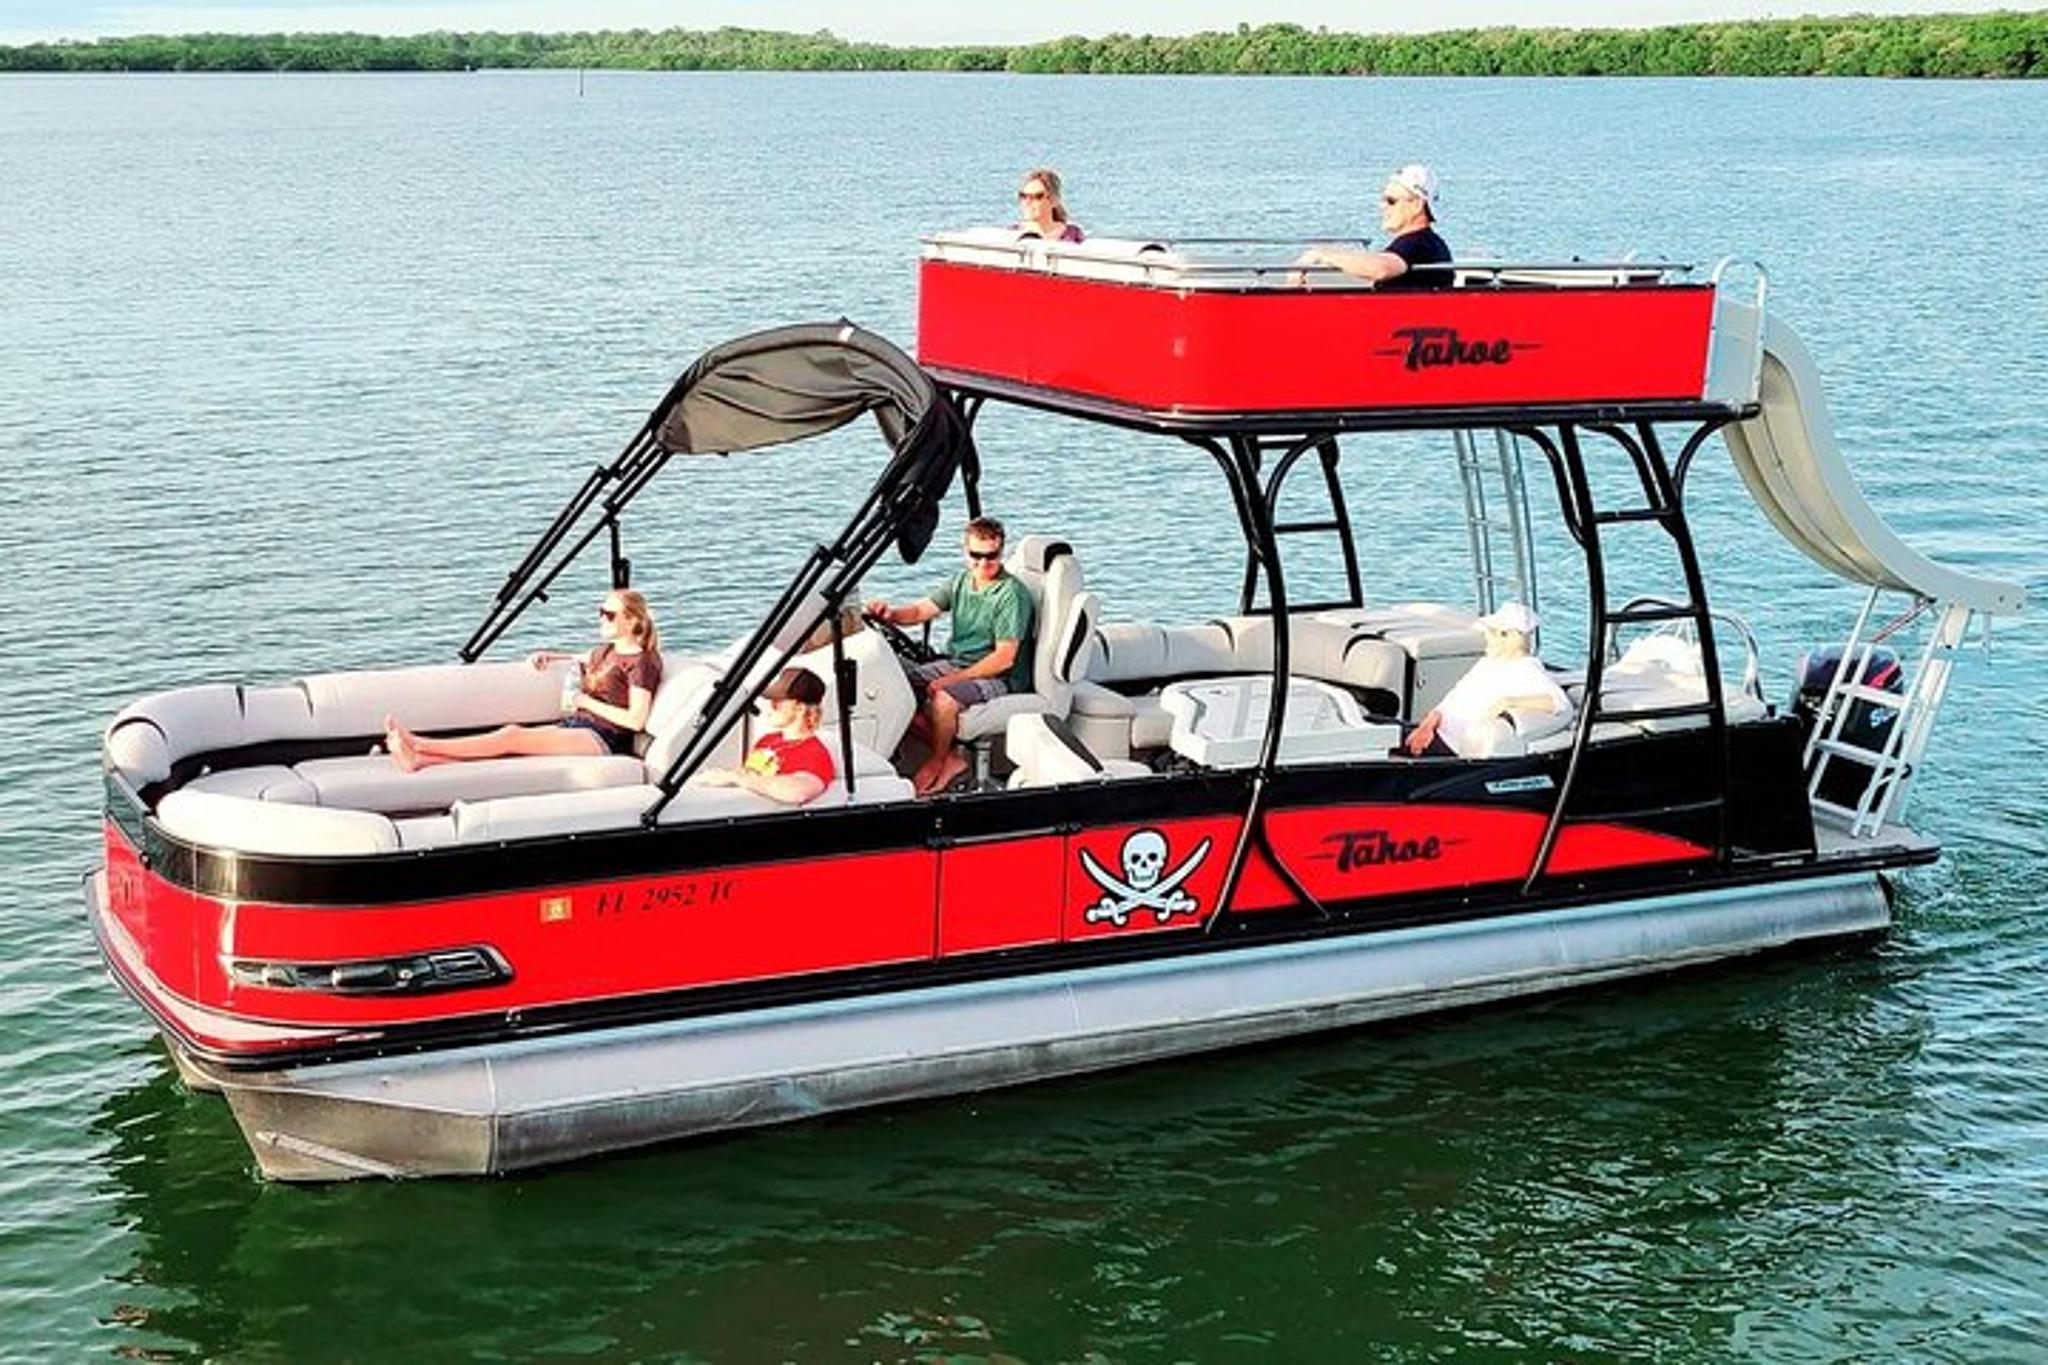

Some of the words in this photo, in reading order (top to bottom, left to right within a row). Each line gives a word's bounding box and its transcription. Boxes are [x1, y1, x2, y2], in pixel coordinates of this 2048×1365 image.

[1390, 327, 1513, 372] Tahoe
[1321, 829, 1441, 873] Tahoe
[640, 883, 698, 912] 2952
